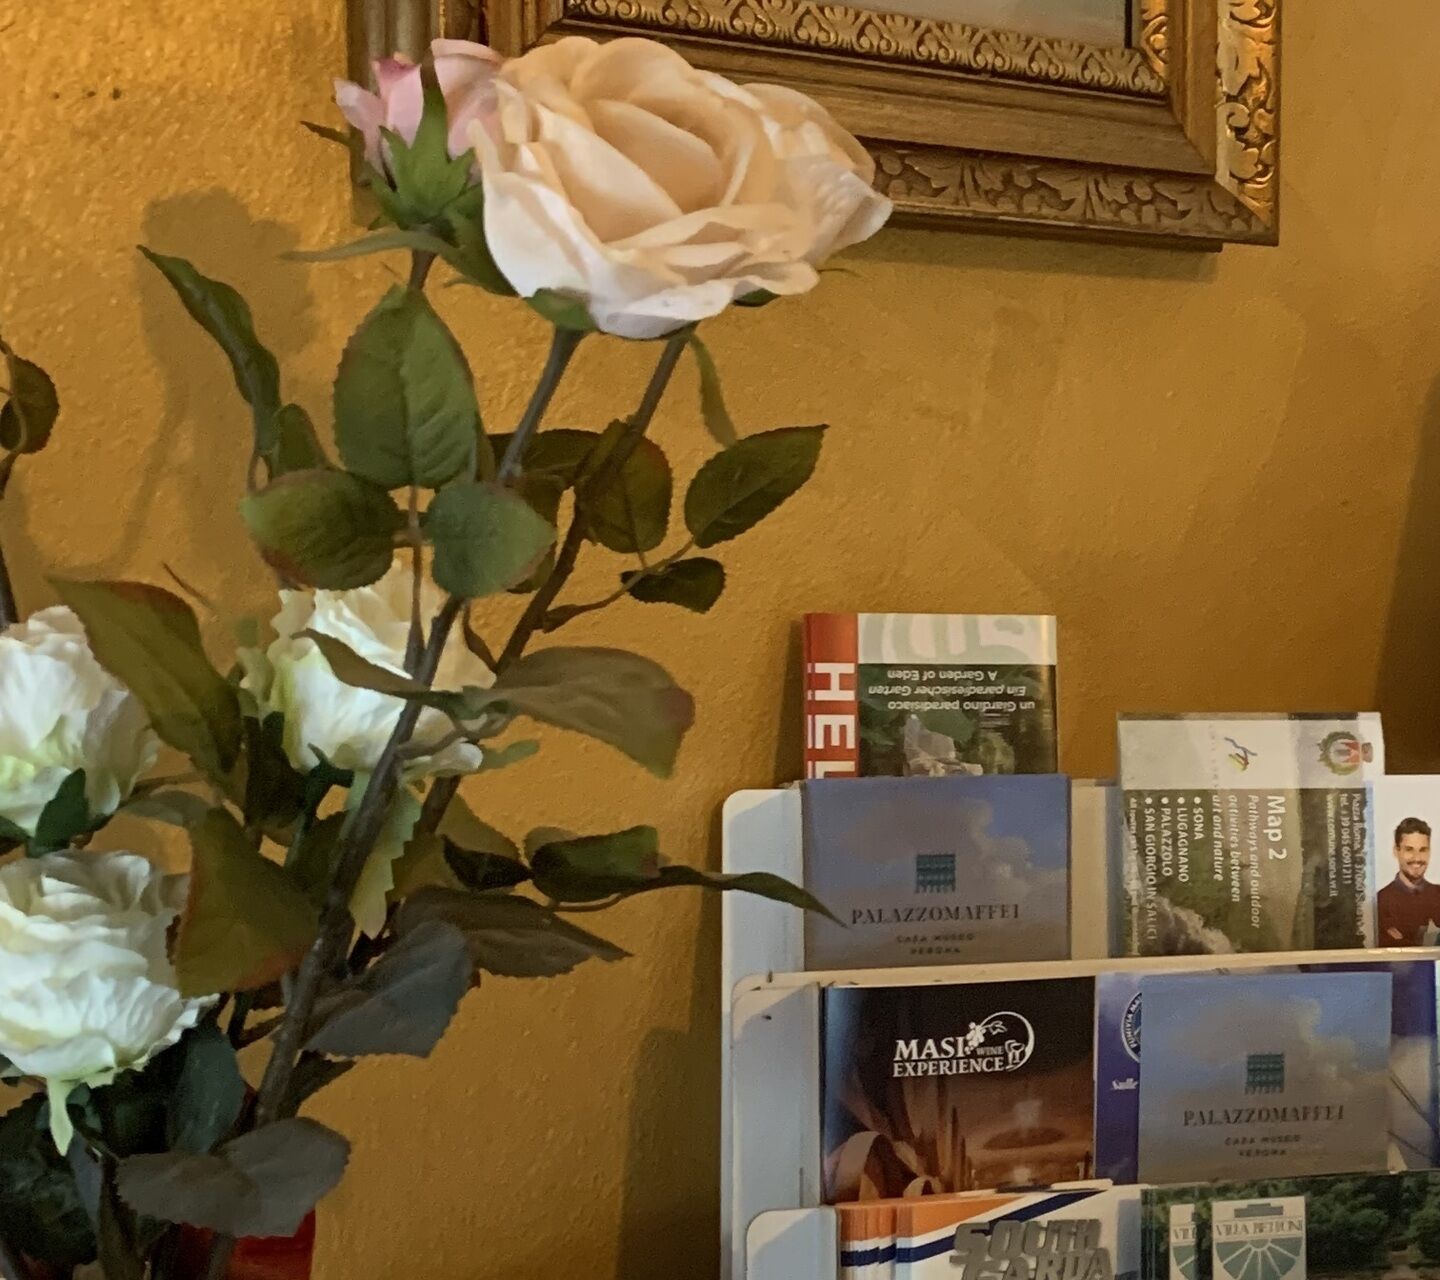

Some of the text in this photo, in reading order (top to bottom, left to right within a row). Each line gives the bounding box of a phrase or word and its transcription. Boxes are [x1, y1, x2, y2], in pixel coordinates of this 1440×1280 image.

[887, 670, 920, 681] Eden
[922, 670, 936, 682] of
[939, 670, 985, 682] Garden
[868, 685, 912, 697] Garten
[1007, 685, 1027, 697] Ein
[887, 699, 1035, 712] un Giardino paradisiaco
[1212, 795, 1223, 817] art
[1193, 807, 1204, 840] SONA
[1212, 817, 1224, 840] and
[1262, 795, 1287, 860] Map 2
[1161, 807, 1173, 877] PALAZZOLO
[1177, 807, 1189, 882] LUGAGNANO
[1228, 795, 1242, 903] activities between
[1144, 807, 1158, 941] SAN GIORGIO IN SALICI
[1212, 840, 1224, 882] nature
[1247, 795, 1262, 929] Pathways and outdoor
[894, 1035, 1004, 1062] MASI WINE
[893, 1056, 1005, 1078] EXPERIENCE
[954, 1219, 1102, 1258] SOUTH
